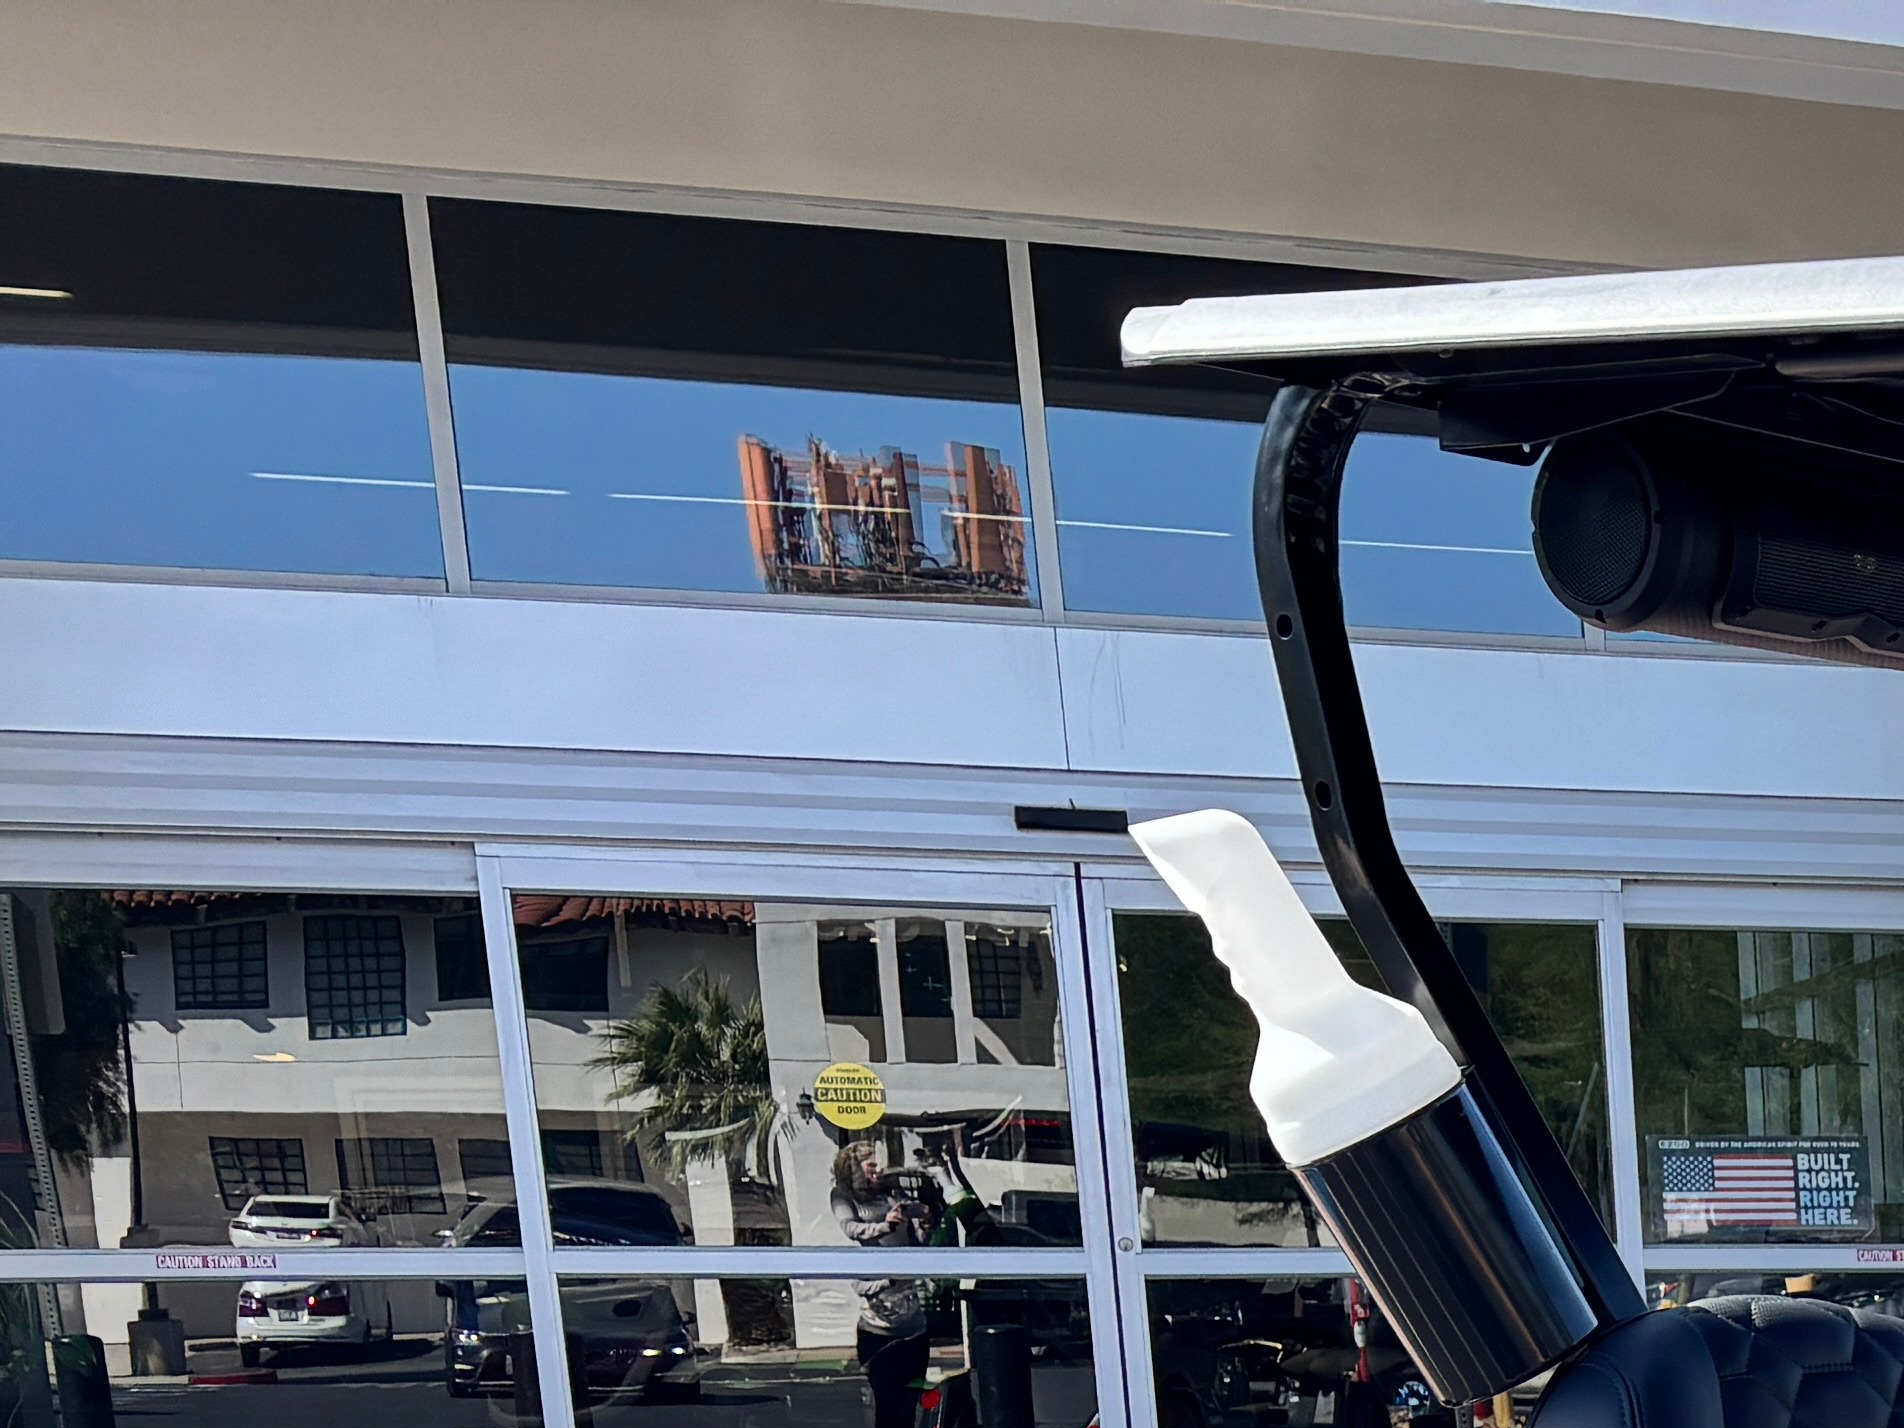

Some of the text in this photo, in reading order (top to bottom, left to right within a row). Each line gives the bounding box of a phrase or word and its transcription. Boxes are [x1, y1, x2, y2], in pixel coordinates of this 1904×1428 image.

[819, 1076, 880, 1085] AUTOMATIC
[817, 1088, 882, 1102] CAUTION
[837, 1105, 867, 1114] DOOR
[1796, 1153, 1851, 1170] BUILT
[1798, 1171, 1860, 1189] RIGHT.
[1799, 1190, 1857, 1207] RIGHT
[1800, 1208, 1859, 1225] HERE.
[158, 1254, 202, 1268] CAUTION
